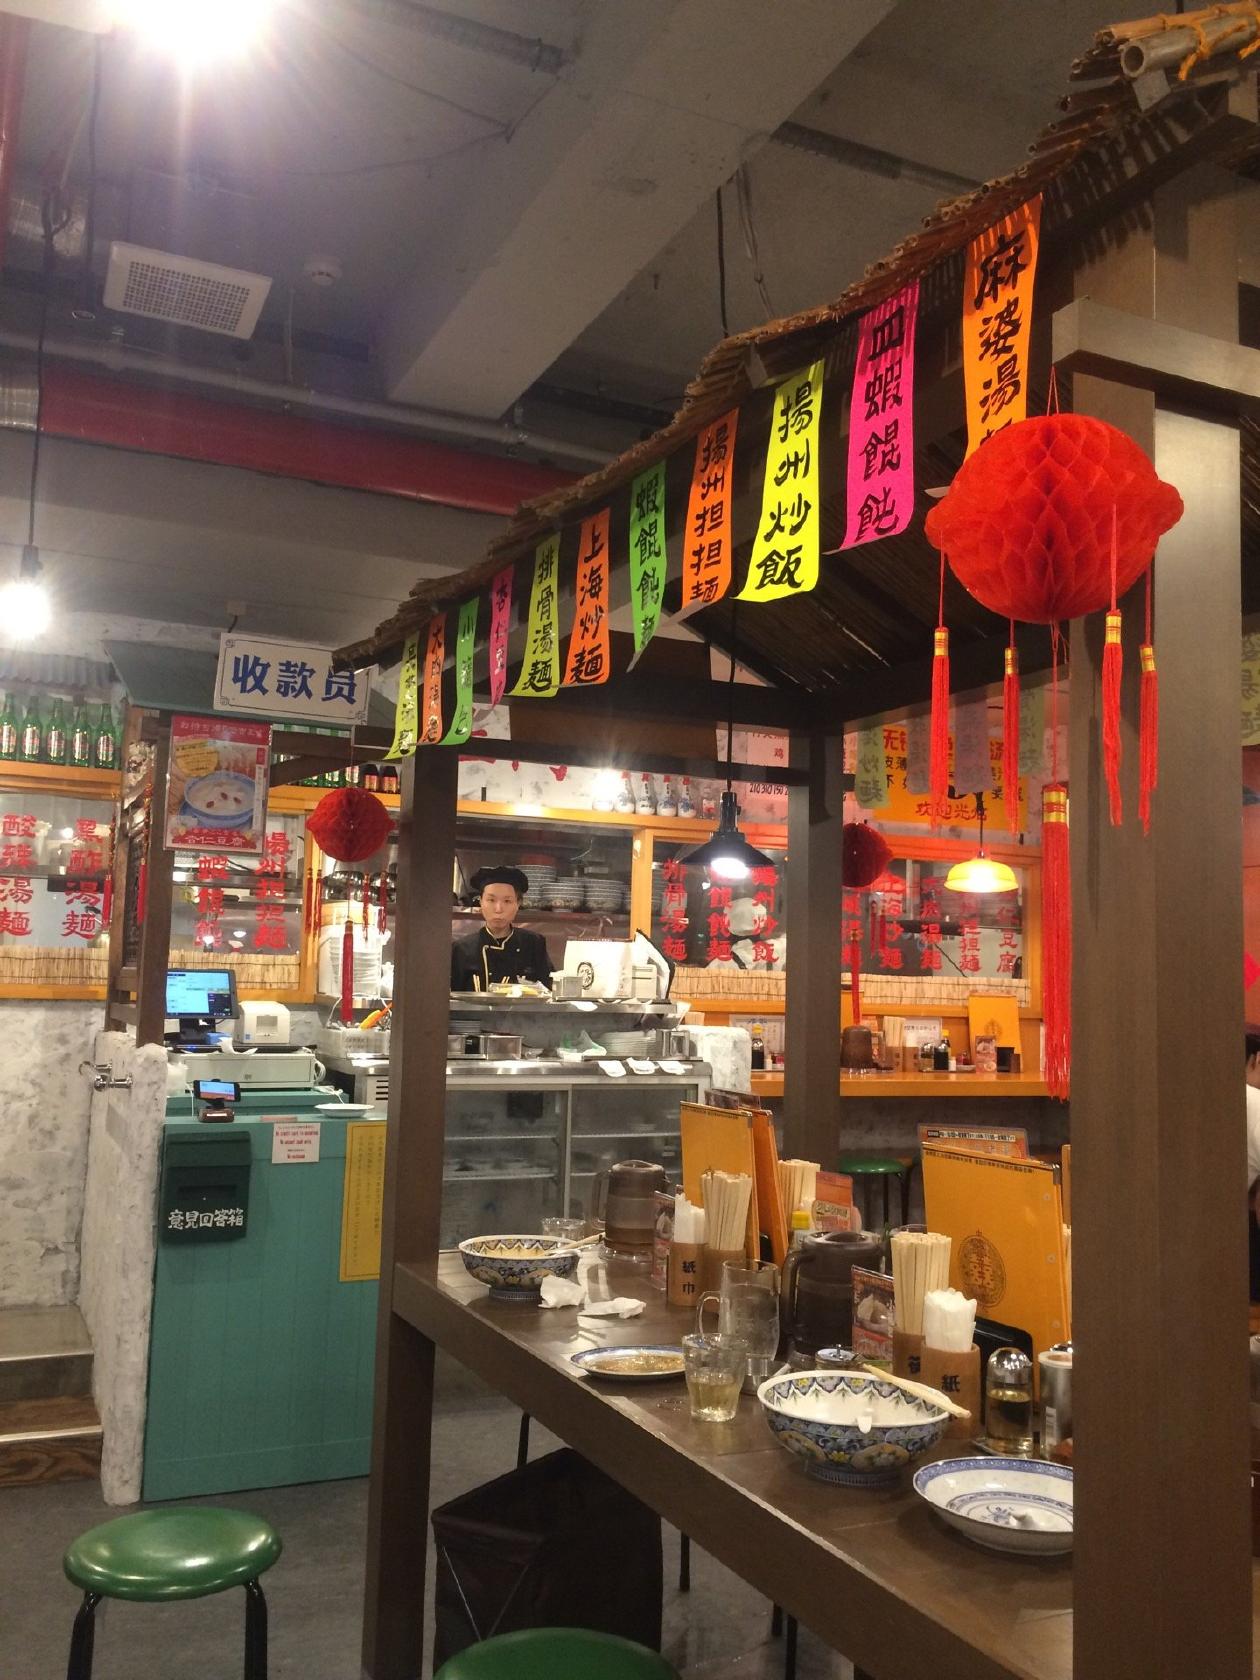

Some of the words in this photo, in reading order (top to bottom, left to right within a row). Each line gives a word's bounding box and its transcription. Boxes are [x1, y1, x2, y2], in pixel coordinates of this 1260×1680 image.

[974, 230, 1028, 446] 麻婆湯
[755, 381, 813, 591] 揚州炒飯
[231, 654, 358, 705] 收款员
[522, 546, 554, 693] 排骨湯麵
[570, 524, 604, 685] 上海炒麵
[168, 1208, 244, 1230] 意見回答箱
